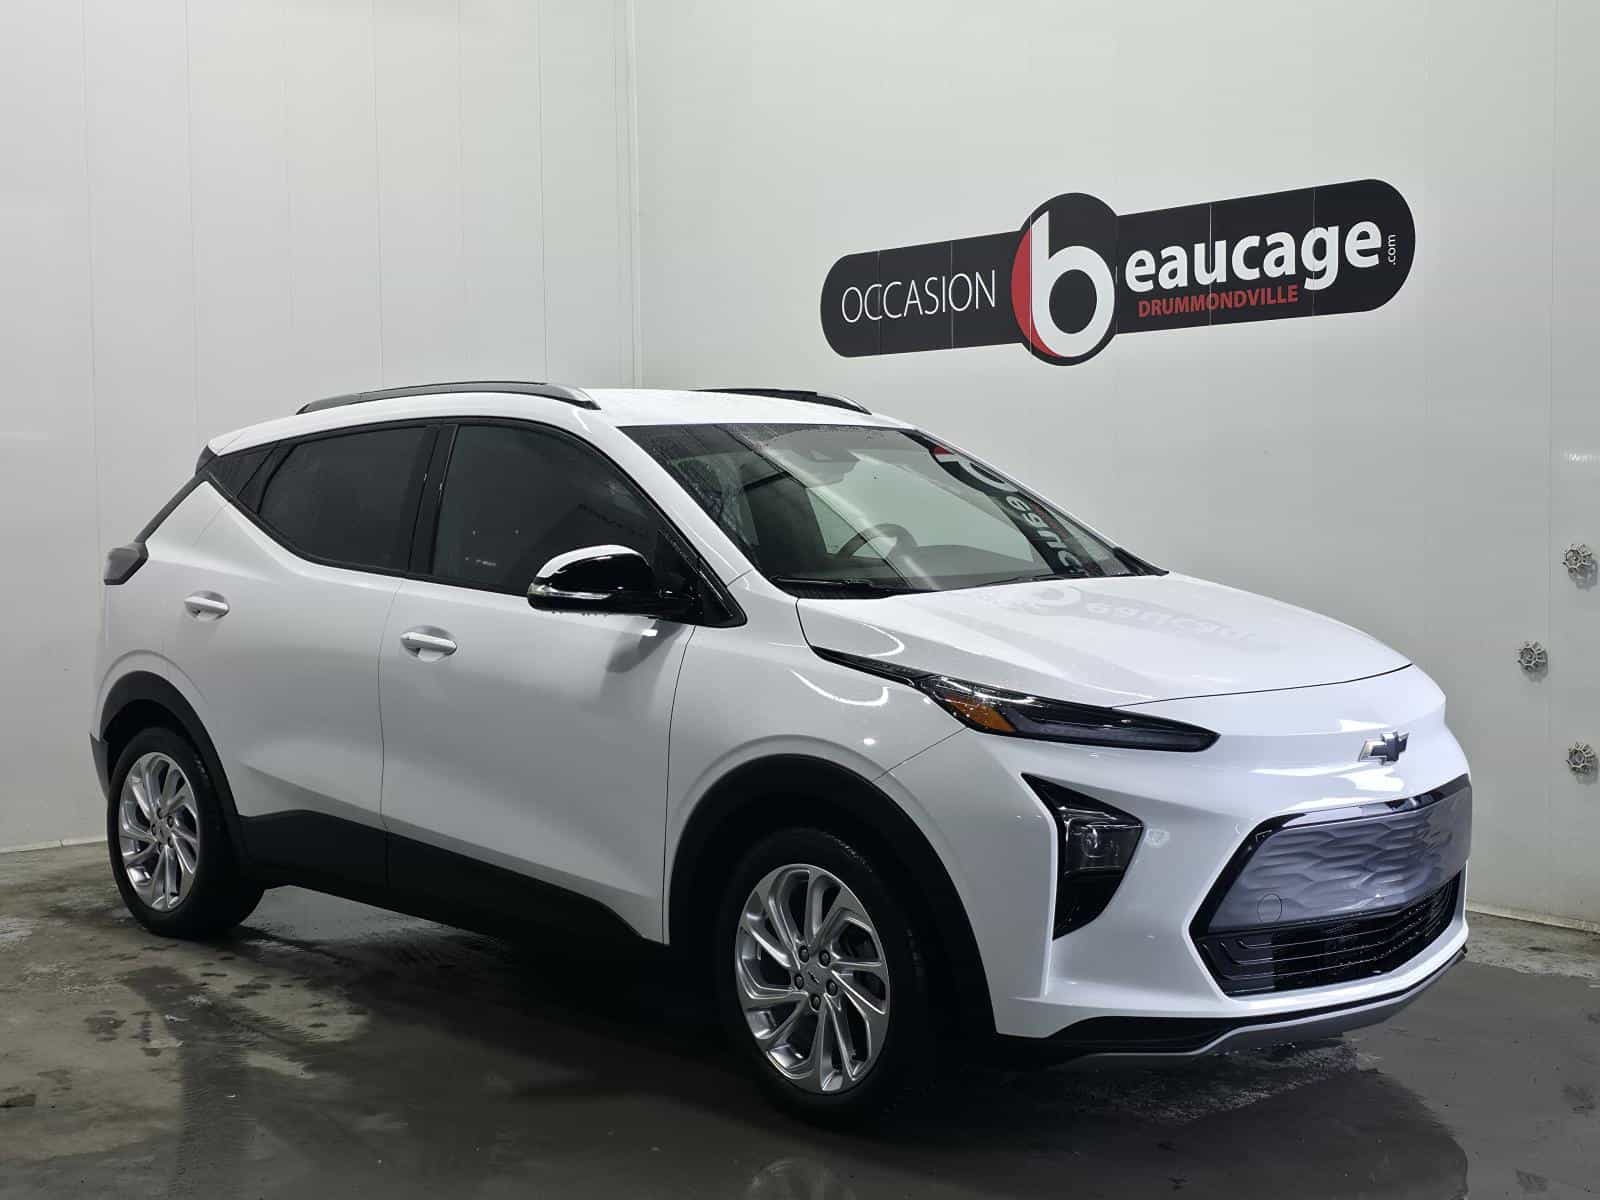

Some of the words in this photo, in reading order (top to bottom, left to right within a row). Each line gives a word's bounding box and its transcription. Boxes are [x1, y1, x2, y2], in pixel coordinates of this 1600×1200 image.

[841, 270, 996, 323] OCCASION
[1387, 234, 1396, 265] .com
[1138, 285, 1298, 317] DRUMMONDVILLE
